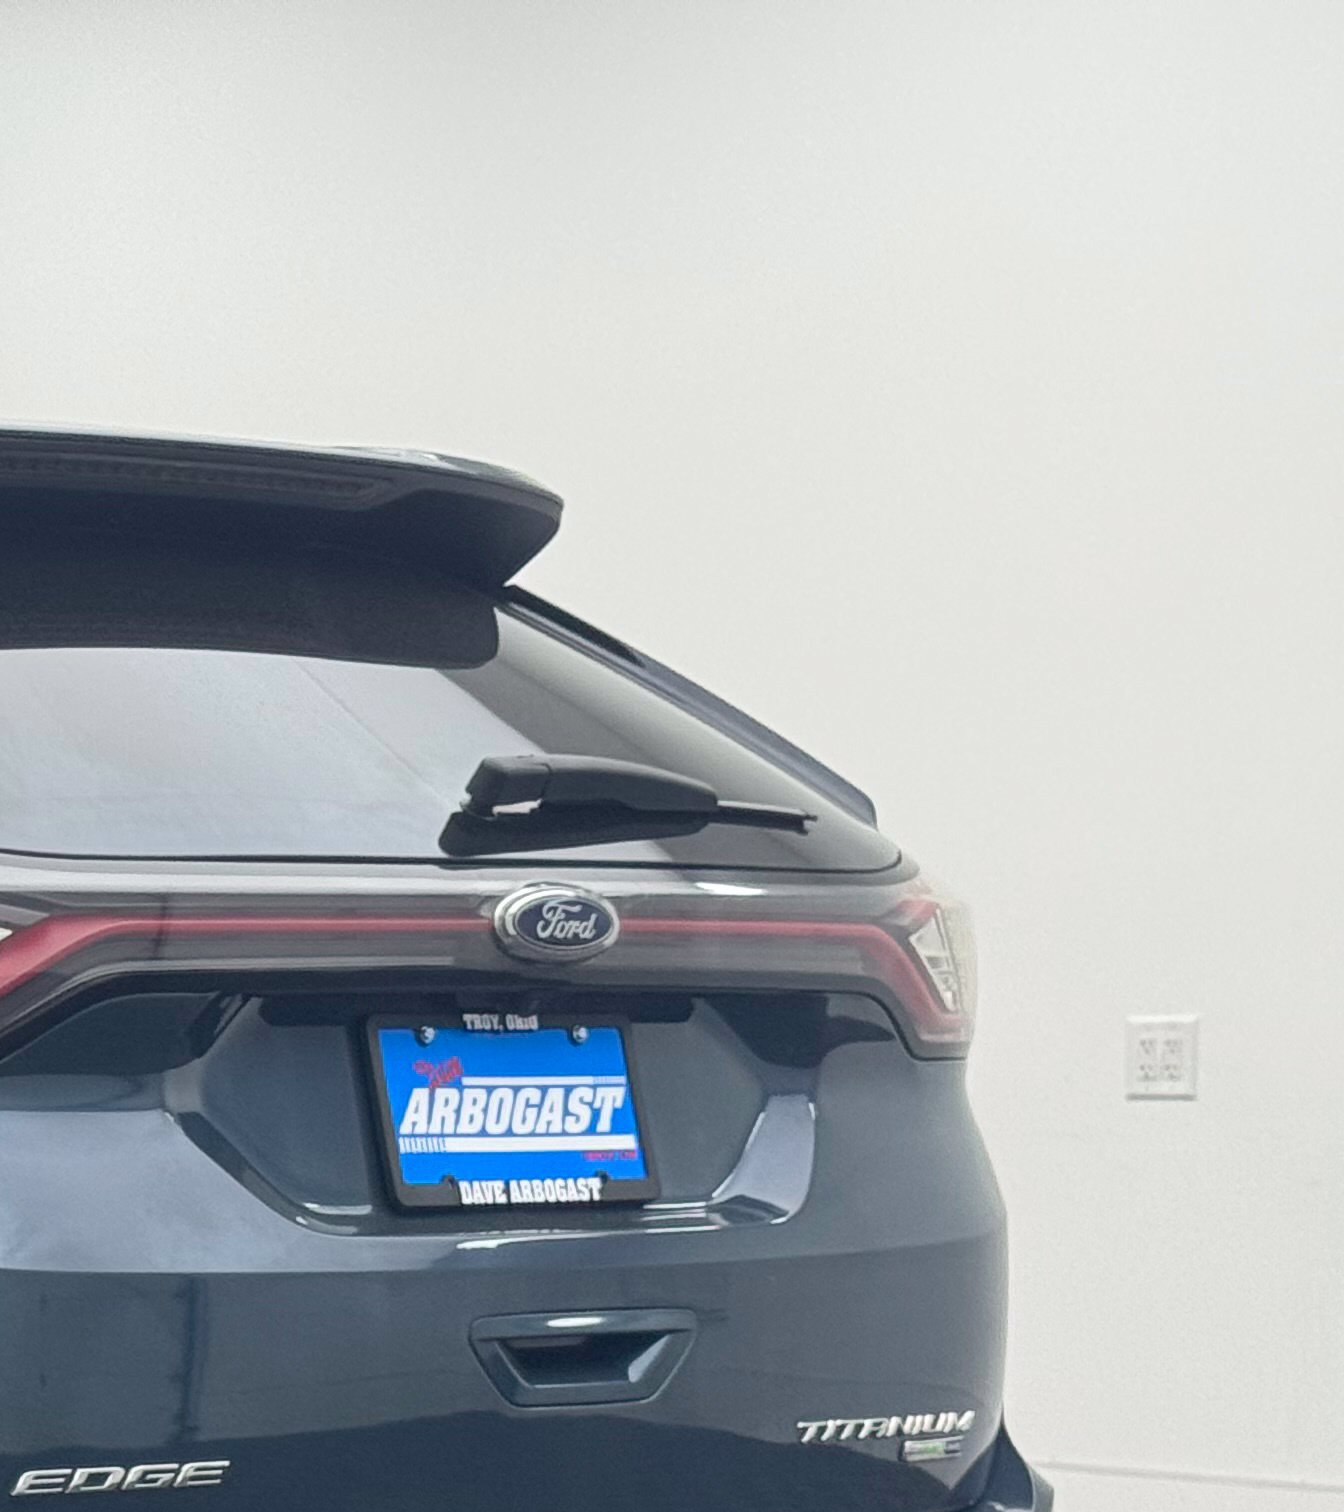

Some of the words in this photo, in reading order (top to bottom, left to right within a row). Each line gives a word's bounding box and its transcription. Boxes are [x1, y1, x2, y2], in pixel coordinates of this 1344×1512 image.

[536, 898, 598, 939] Ford
[399, 1086, 627, 1135] ARBOGAST
[459, 1179, 507, 1205] DAVE
[509, 1176, 603, 1204] ARBOGAST
[796, 1409, 976, 1444] TITANIUM
[10, 1460, 231, 1496] EDGE
